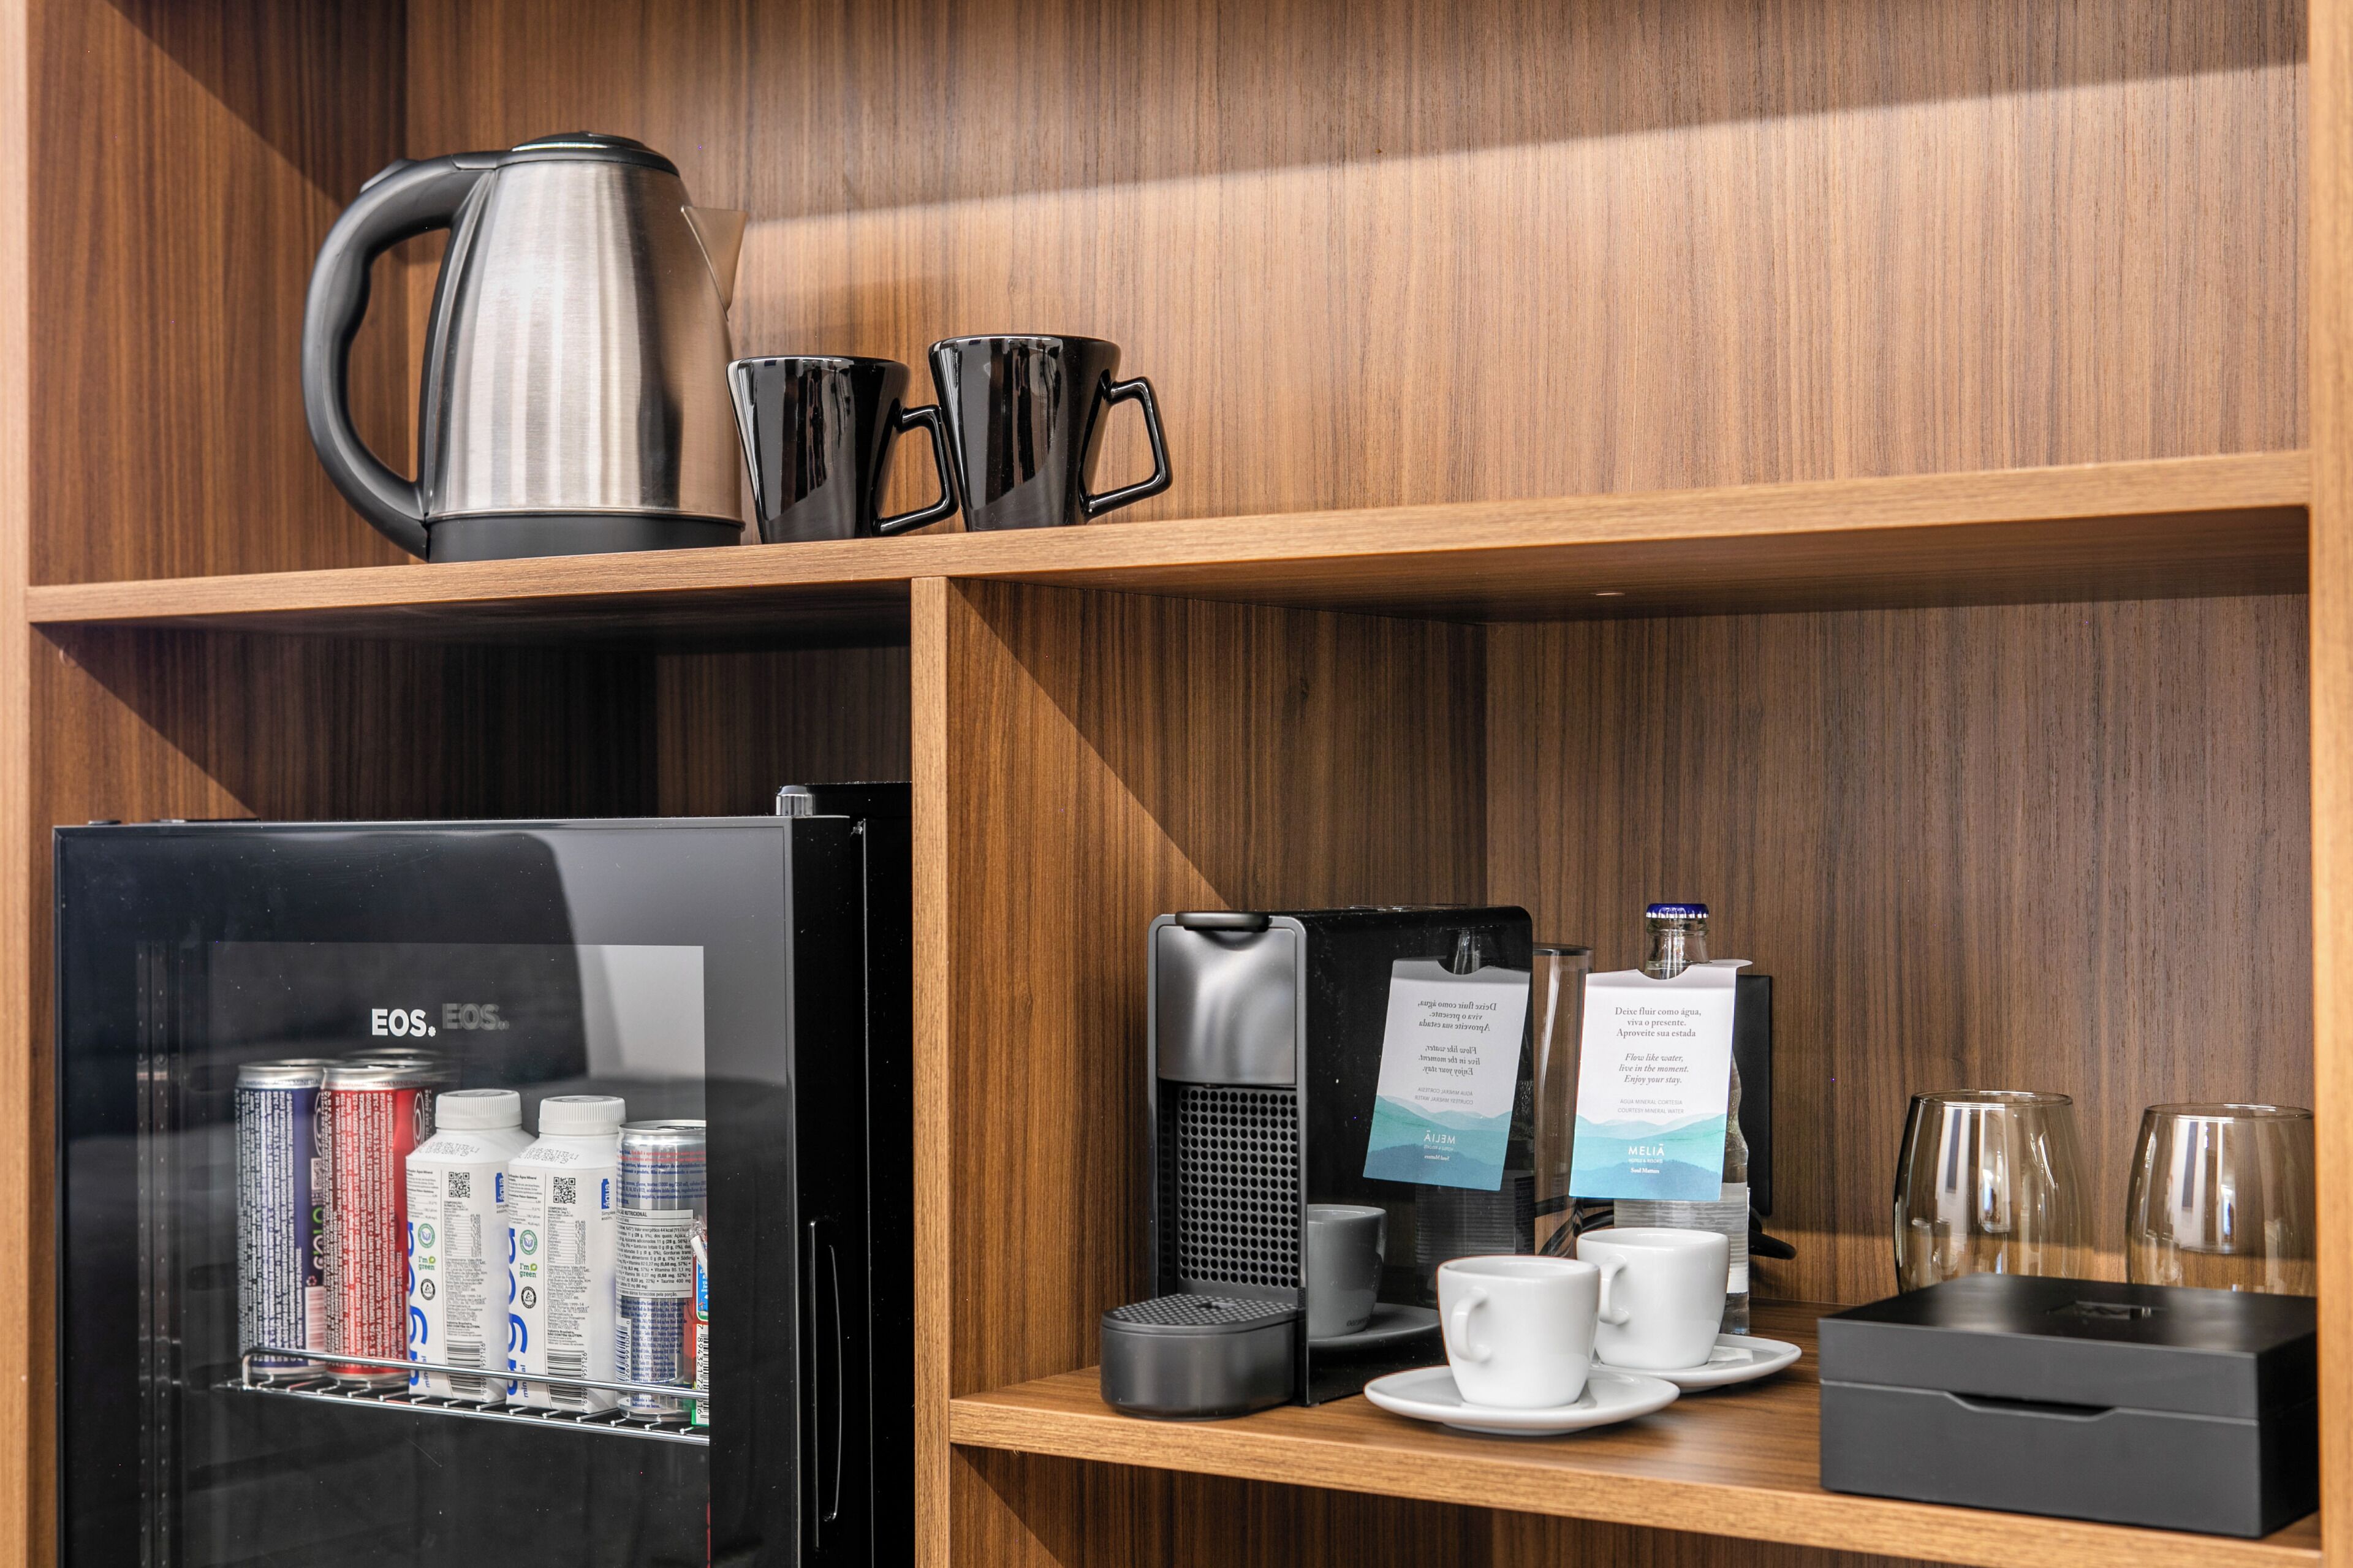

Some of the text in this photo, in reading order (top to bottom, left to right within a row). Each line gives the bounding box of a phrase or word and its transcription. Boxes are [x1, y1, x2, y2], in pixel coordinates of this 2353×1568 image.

[1681, 1008, 1701, 1017] água,
[1651, 1020, 1686, 1028] presente.
[1616, 1029, 1655, 1039] Aproveite
[1624, 1075, 1646, 1085] Enjoy
[1665, 1077, 1682, 1086] stay.
